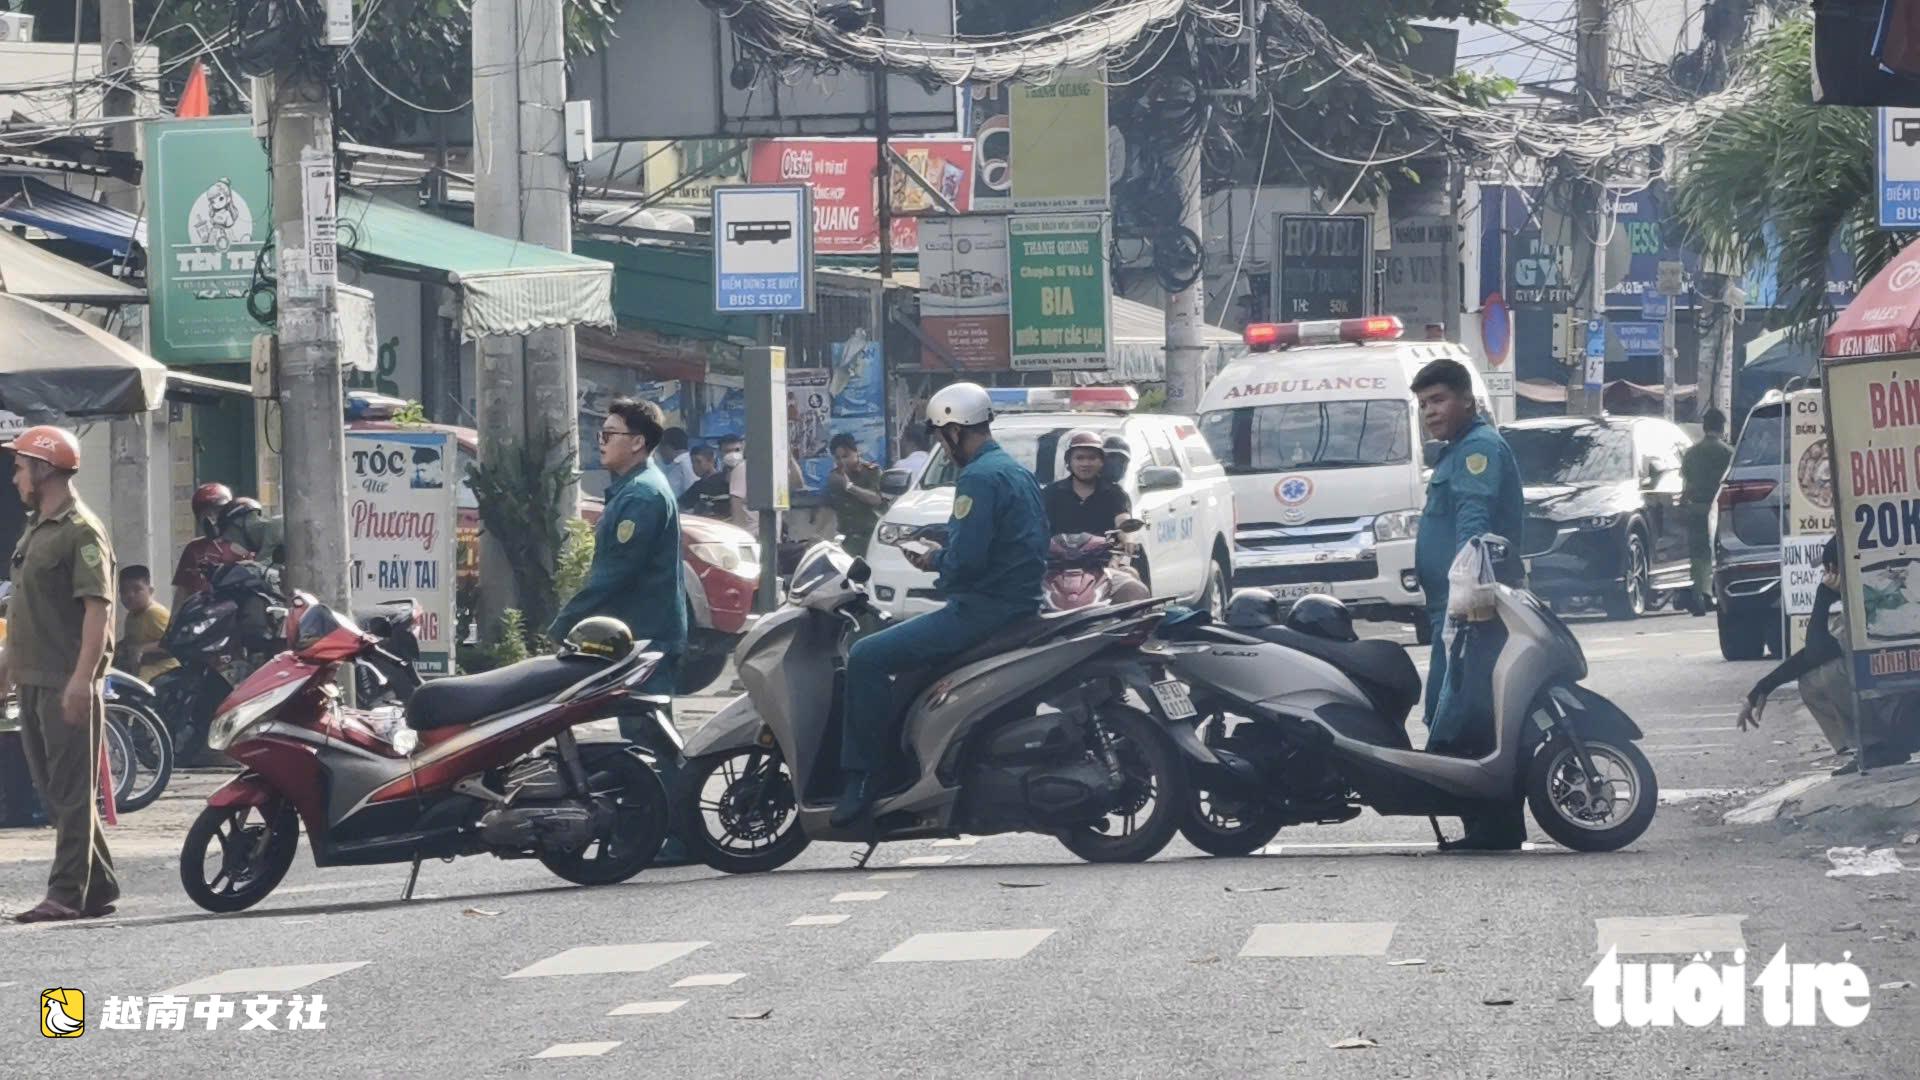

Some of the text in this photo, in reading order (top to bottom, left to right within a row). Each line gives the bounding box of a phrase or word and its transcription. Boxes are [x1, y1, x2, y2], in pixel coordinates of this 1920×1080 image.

[1896, 207, 1920, 220] BU
[1023, 240, 1056, 256] THANH
[1057, 239, 1089, 255] QUANG
[1284, 221, 1361, 257] HOTEL
[767, 277, 777, 290] XE
[729, 293, 793, 305] BUS STOP
[1041, 286, 1074, 316] BIA
[1224, 376, 1387, 400] AMBULANCE
[352, 444, 408, 476] TÓC
[1850, 440, 1908, 497] BÁNH
[351, 499, 441, 552] Phương
[414, 559, 438, 589] TAI
